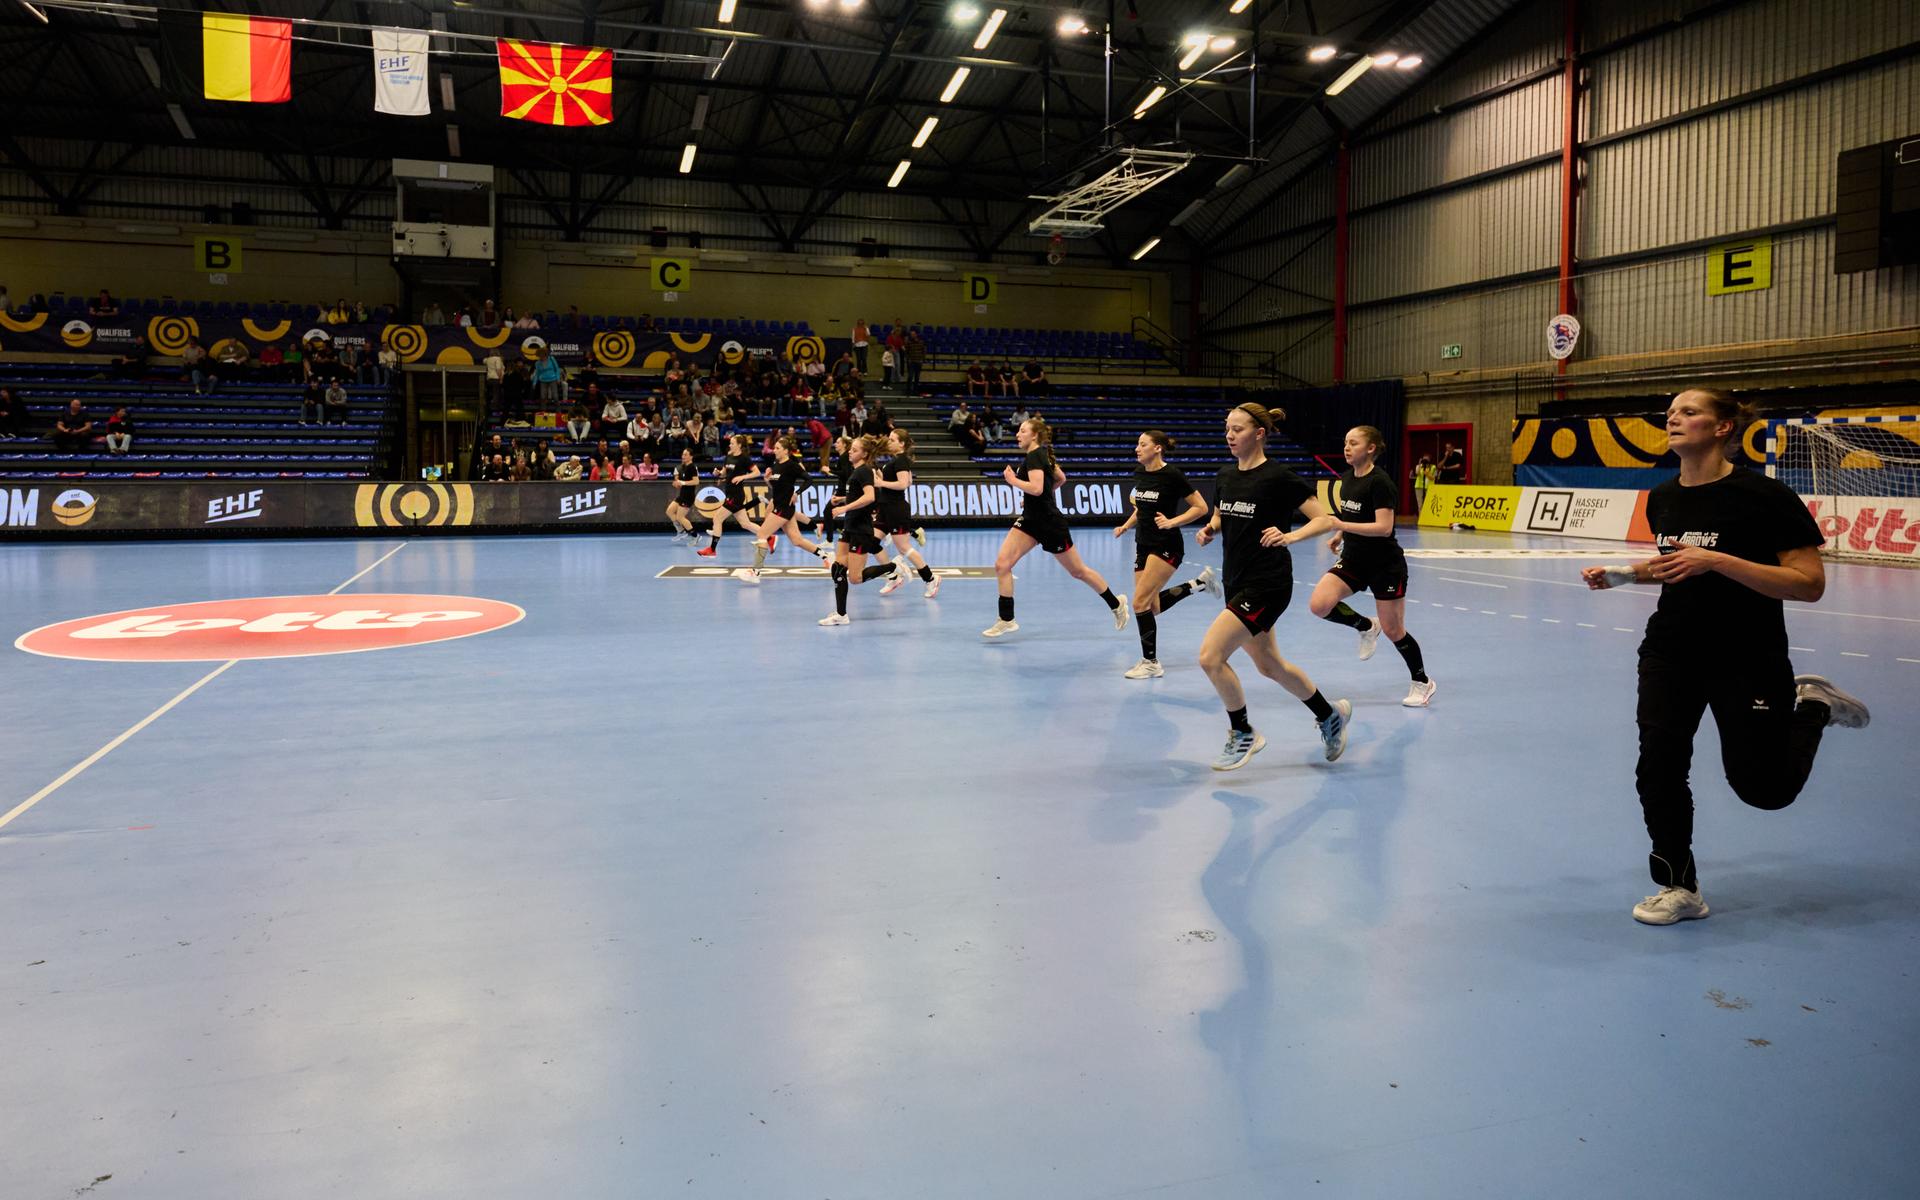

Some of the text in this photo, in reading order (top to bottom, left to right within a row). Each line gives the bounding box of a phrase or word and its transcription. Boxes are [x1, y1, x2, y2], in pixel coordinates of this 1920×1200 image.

[380, 56, 409, 69] EHF
[205, 240, 231, 268] B
[660, 262, 681, 288] C
[1723, 245, 1754, 288] E
[972, 277, 990, 299] D
[96, 328, 131, 337] QUALIFIERS
[207, 489, 263, 518] EHF
[561, 488, 606, 514] EHF
[1454, 496, 1509, 511] SPORT.
[1575, 499, 1609, 508] HASSELT
[1452, 510, 1508, 520] VLAANDEREN
[1540, 502, 1559, 521] H.
[1572, 509, 1596, 518] HEEFT
[1569, 519, 1585, 528] HET.
